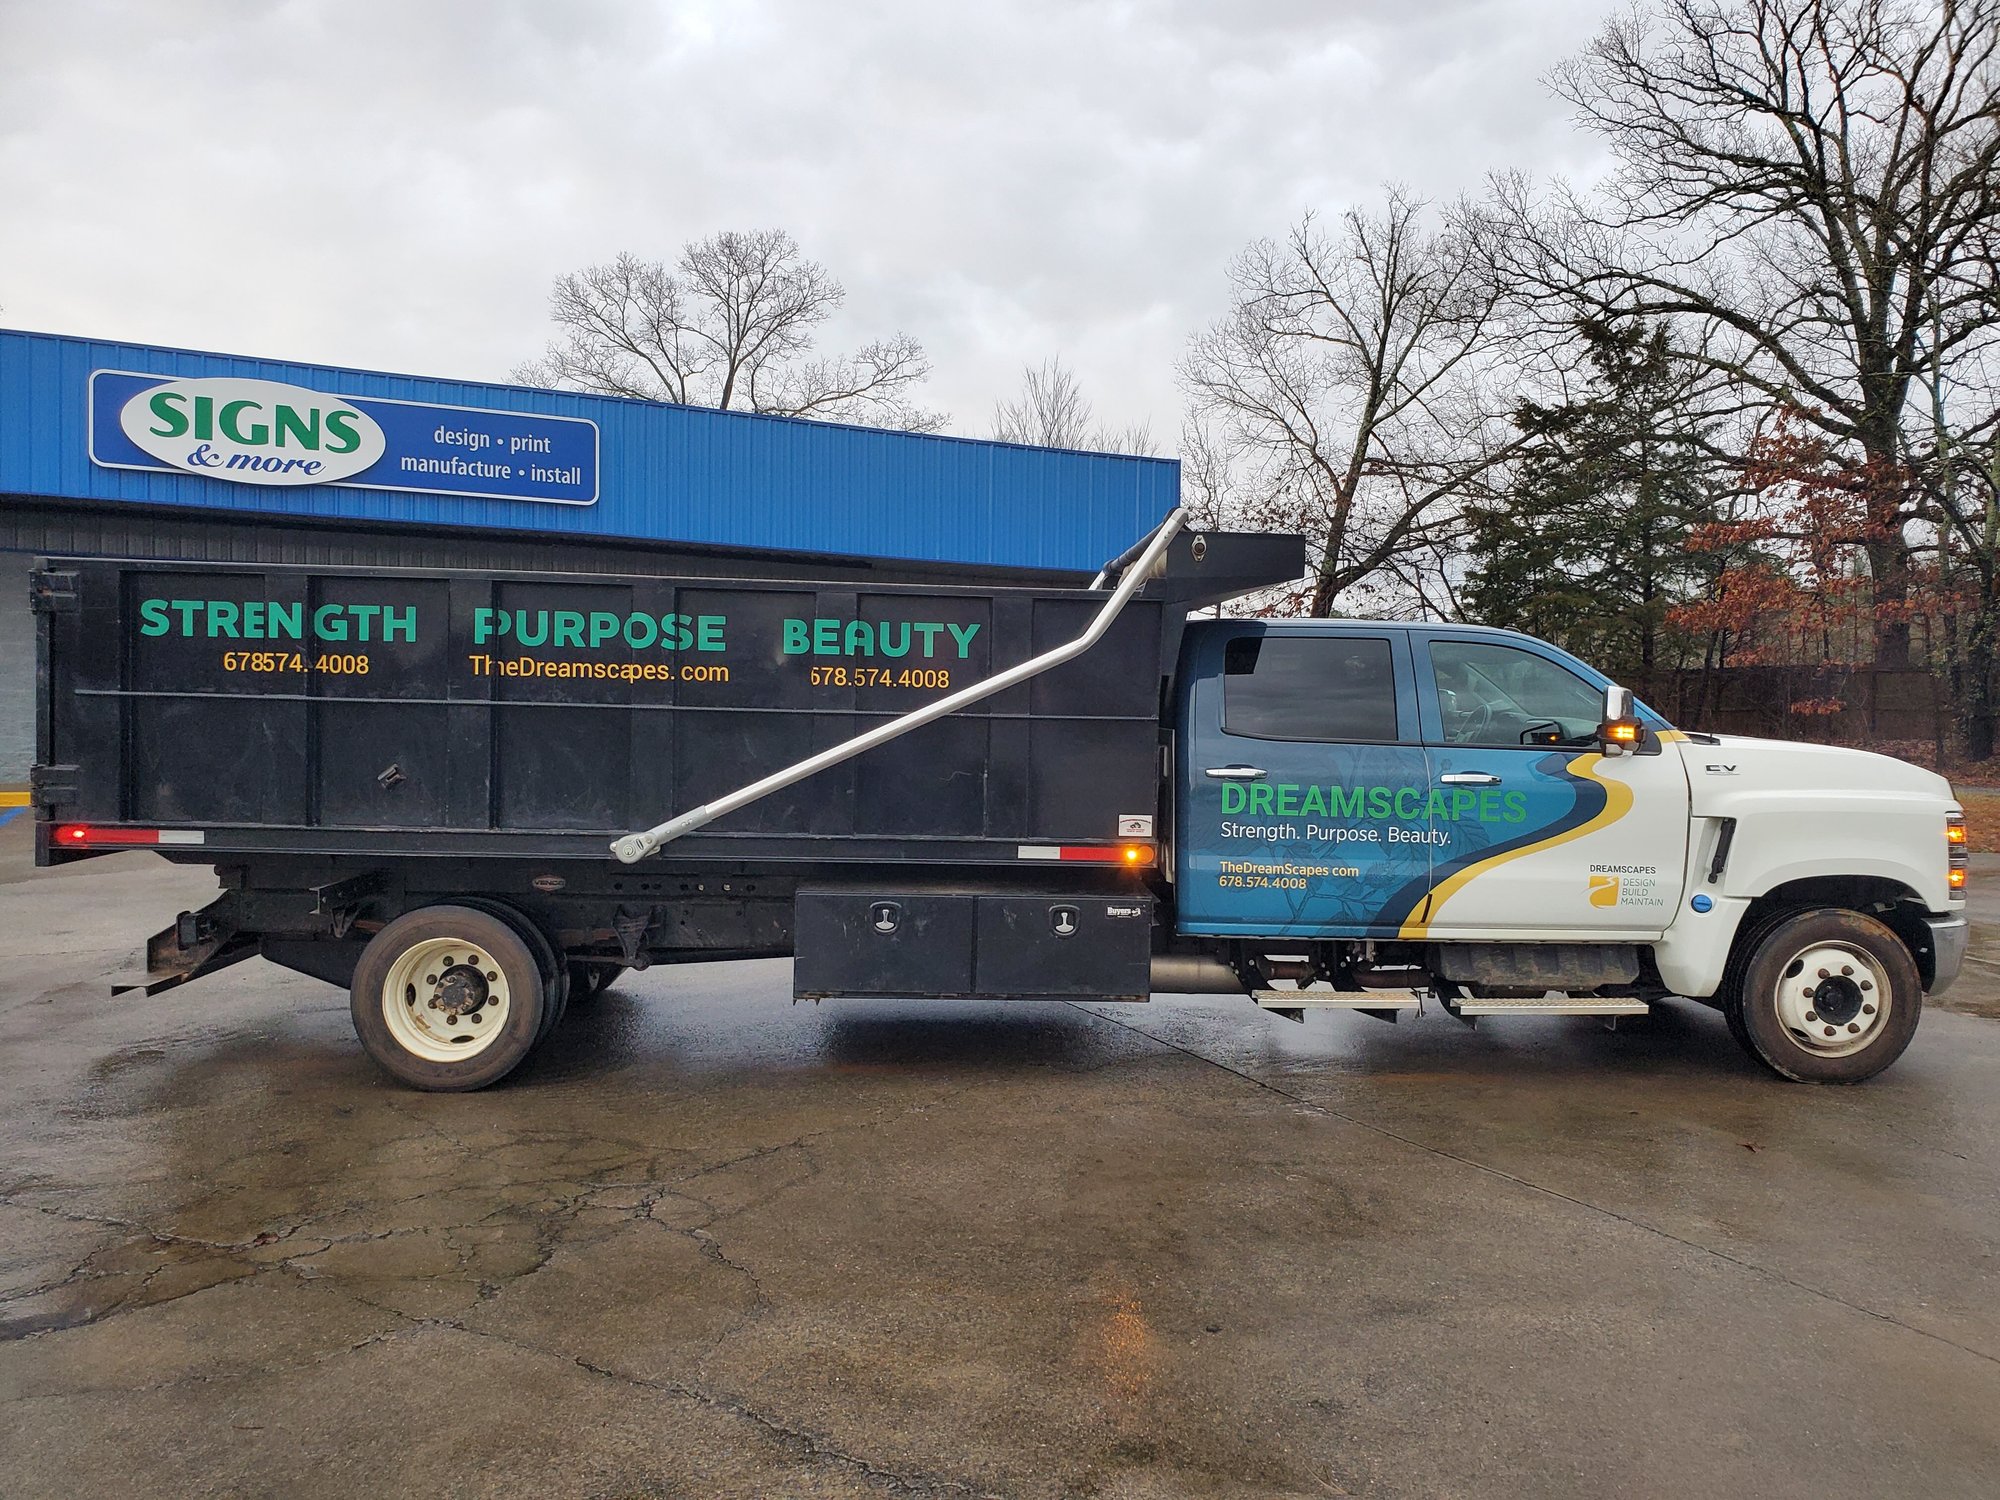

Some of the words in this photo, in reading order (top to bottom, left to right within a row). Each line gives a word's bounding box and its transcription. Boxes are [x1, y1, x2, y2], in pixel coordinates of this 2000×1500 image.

[149, 391, 361, 454] SIGNS
[433, 425, 490, 451] design
[510, 434, 551, 454] print
[187, 443, 224, 468] &
[226, 453, 326, 476] more
[401, 456, 511, 479] manufacture
[531, 464, 581, 485] install
[474, 607, 727, 652] PURPOSE
[783, 618, 981, 659] BEAUTY
[810, 666, 950, 689] 678.574.4008
[1221, 782, 1528, 824] DREAMSCAPES
[1220, 821, 1301, 842] Strength.
[1306, 824, 1382, 844] Purpose.
[1388, 826, 1452, 847] Beauty.
[1219, 875, 1307, 890] 678.574.4008
[1589, 864, 1657, 875] DREAMSCAPES
[1622, 878, 1656, 887] DESIGN
[1620, 897, 1664, 907] MAINTAIN
[1621, 888, 1649, 897] BUILD
[1107, 906, 1131, 916] Buyers
